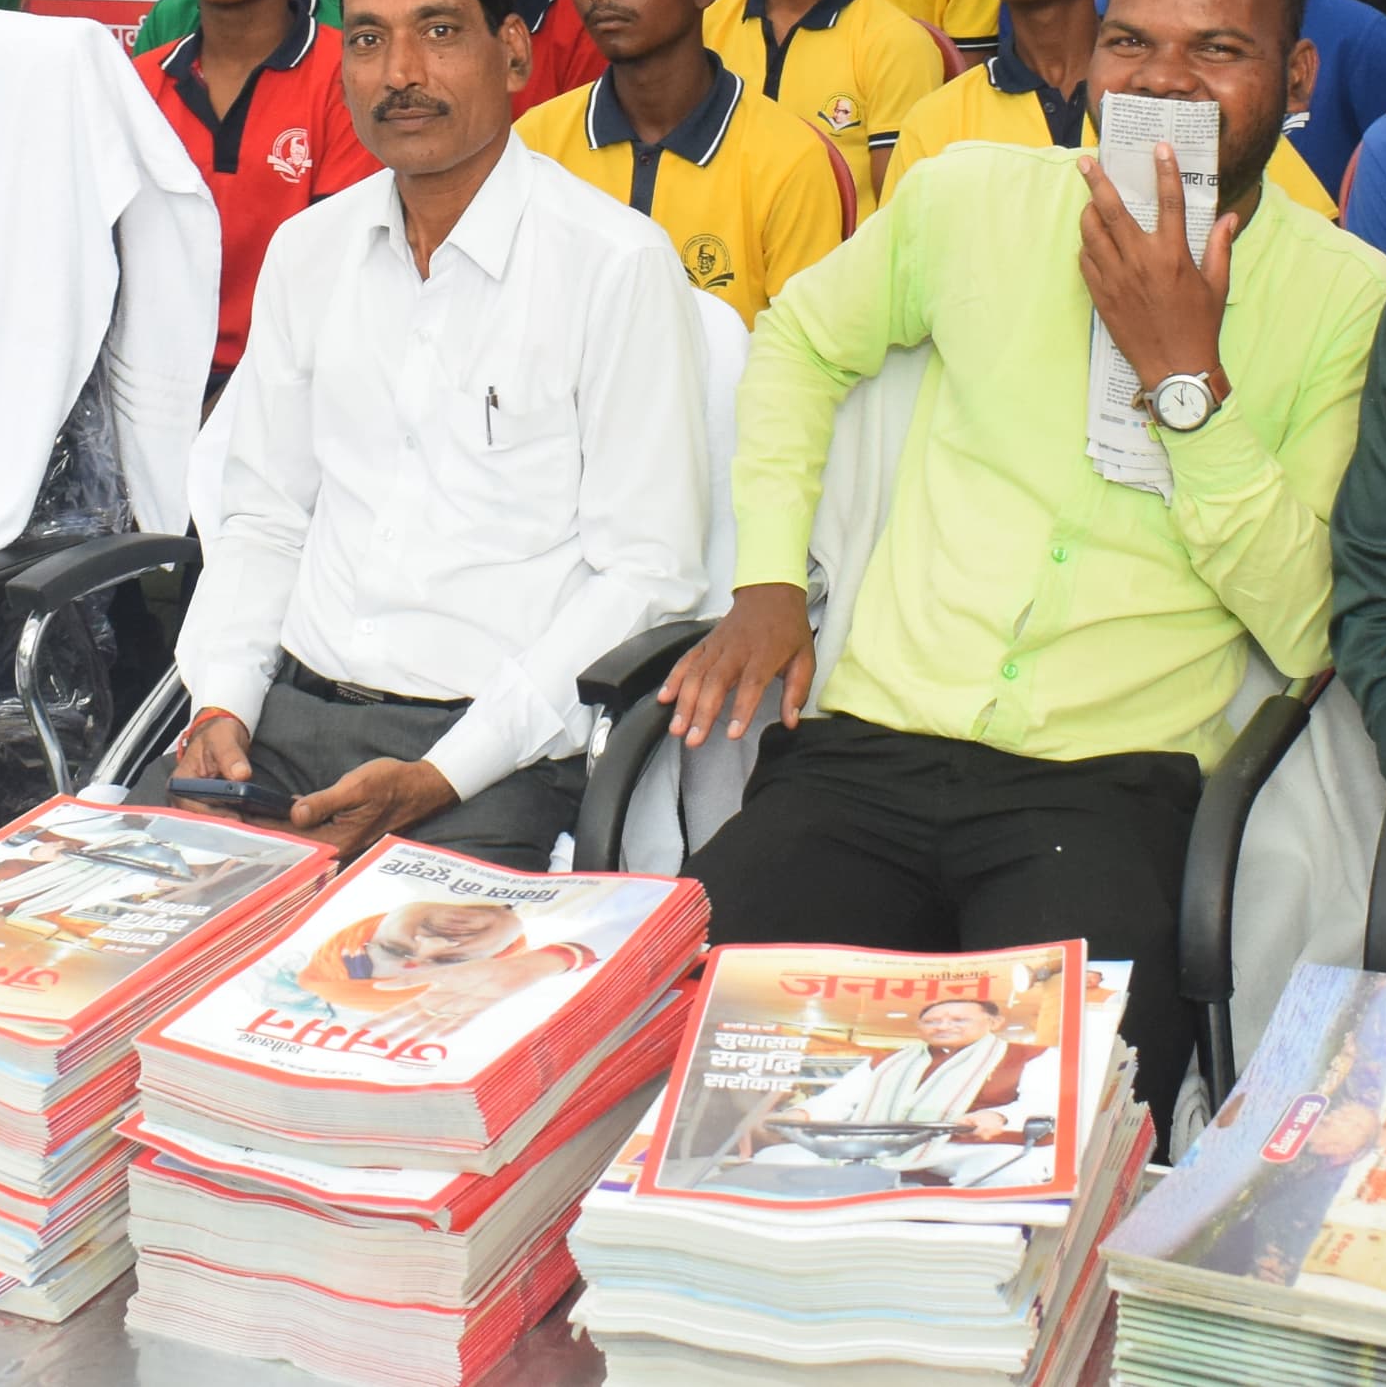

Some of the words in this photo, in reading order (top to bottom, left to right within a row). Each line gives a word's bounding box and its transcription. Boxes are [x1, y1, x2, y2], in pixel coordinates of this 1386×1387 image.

[778, 972, 993, 1002] जनमन
[235, 1009, 448, 1069] जनमन
[714, 1031, 810, 1052] सुशासन
[709, 1050, 806, 1076] समृद्धि
[703, 1072, 794, 1093] सरोकार
